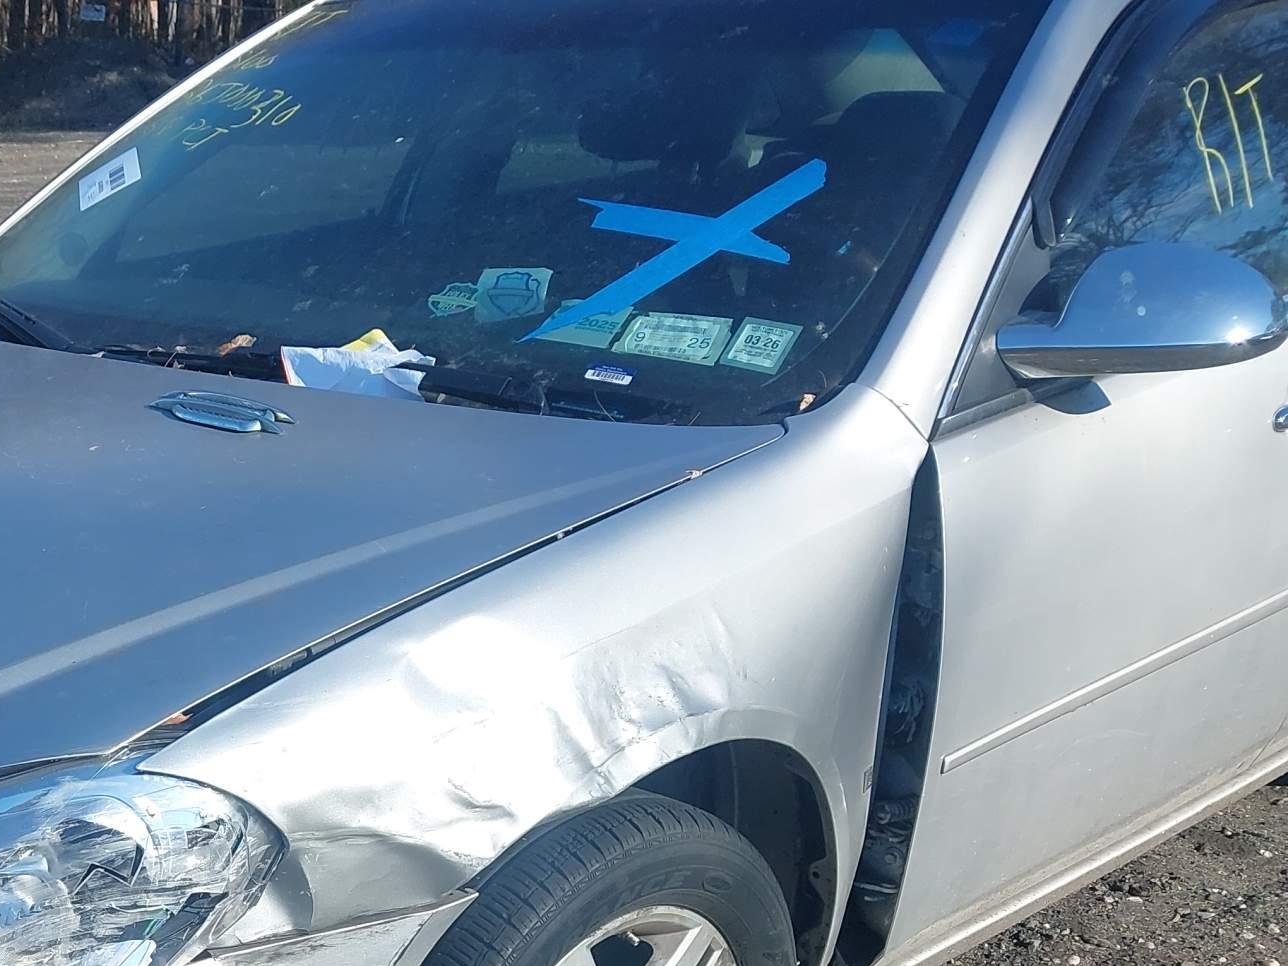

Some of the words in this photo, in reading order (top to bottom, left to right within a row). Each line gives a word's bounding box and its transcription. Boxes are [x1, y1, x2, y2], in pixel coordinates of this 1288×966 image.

[577, 317, 620, 330] 2025
[633, 331, 646, 342] 9
[687, 337, 710, 349] 25
[743, 333, 760, 346] 03
[763, 338, 780, 350] 26
